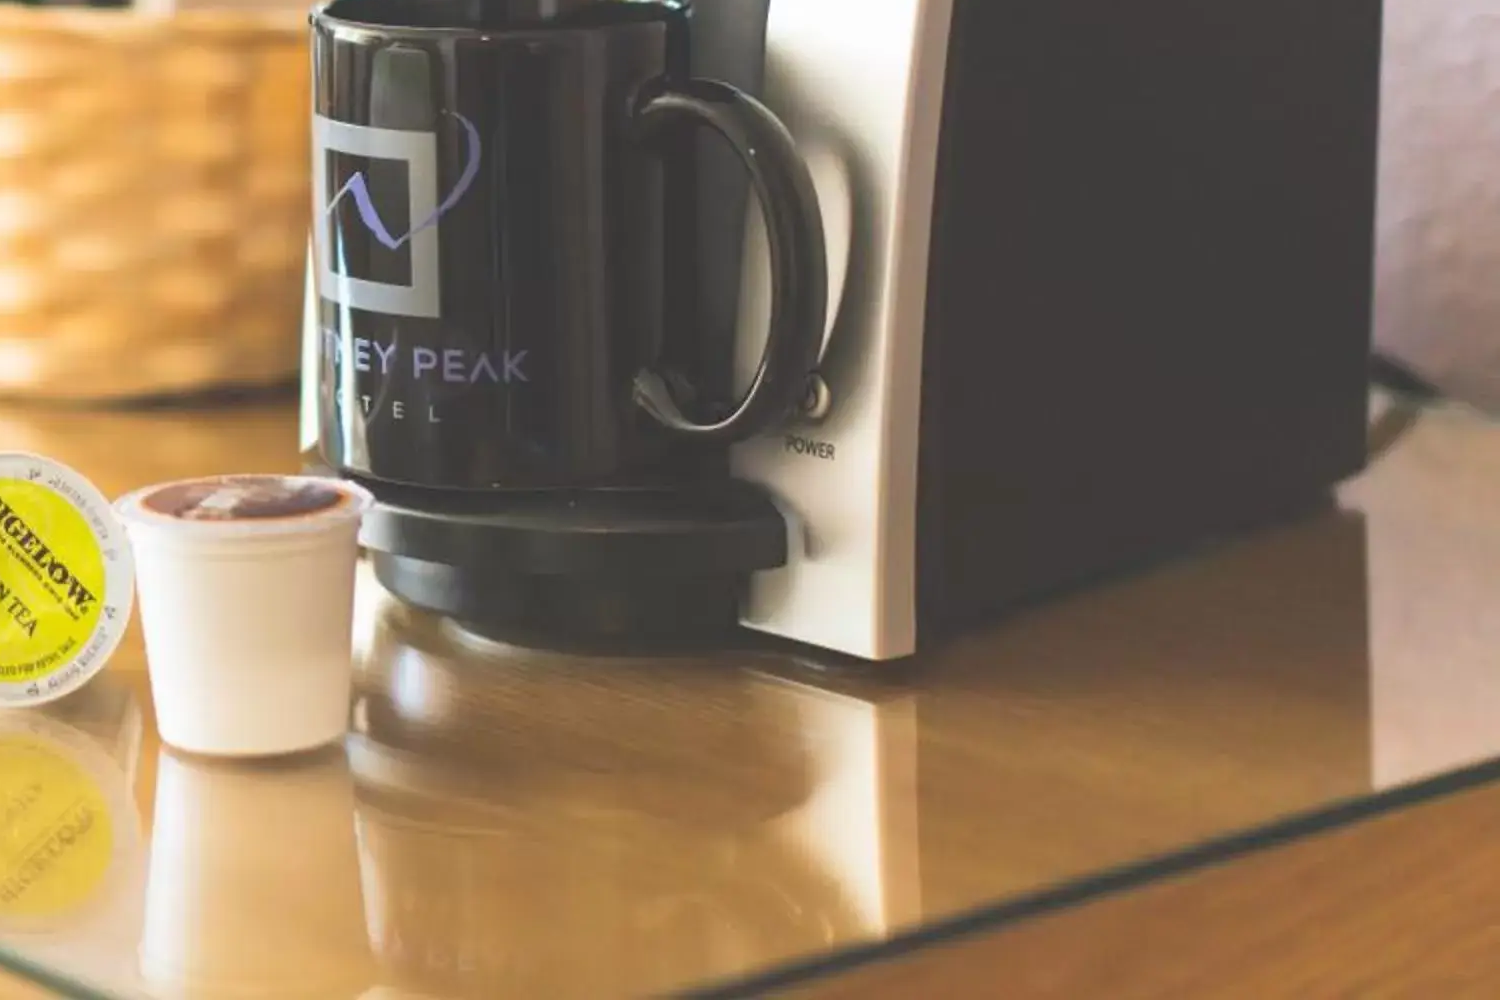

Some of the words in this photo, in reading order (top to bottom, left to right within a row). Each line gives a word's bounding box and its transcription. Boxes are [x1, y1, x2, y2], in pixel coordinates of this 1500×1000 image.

[412, 345, 531, 384] PEAK
[784, 434, 836, 461] POWER
[7, 595, 38, 639] TEA
